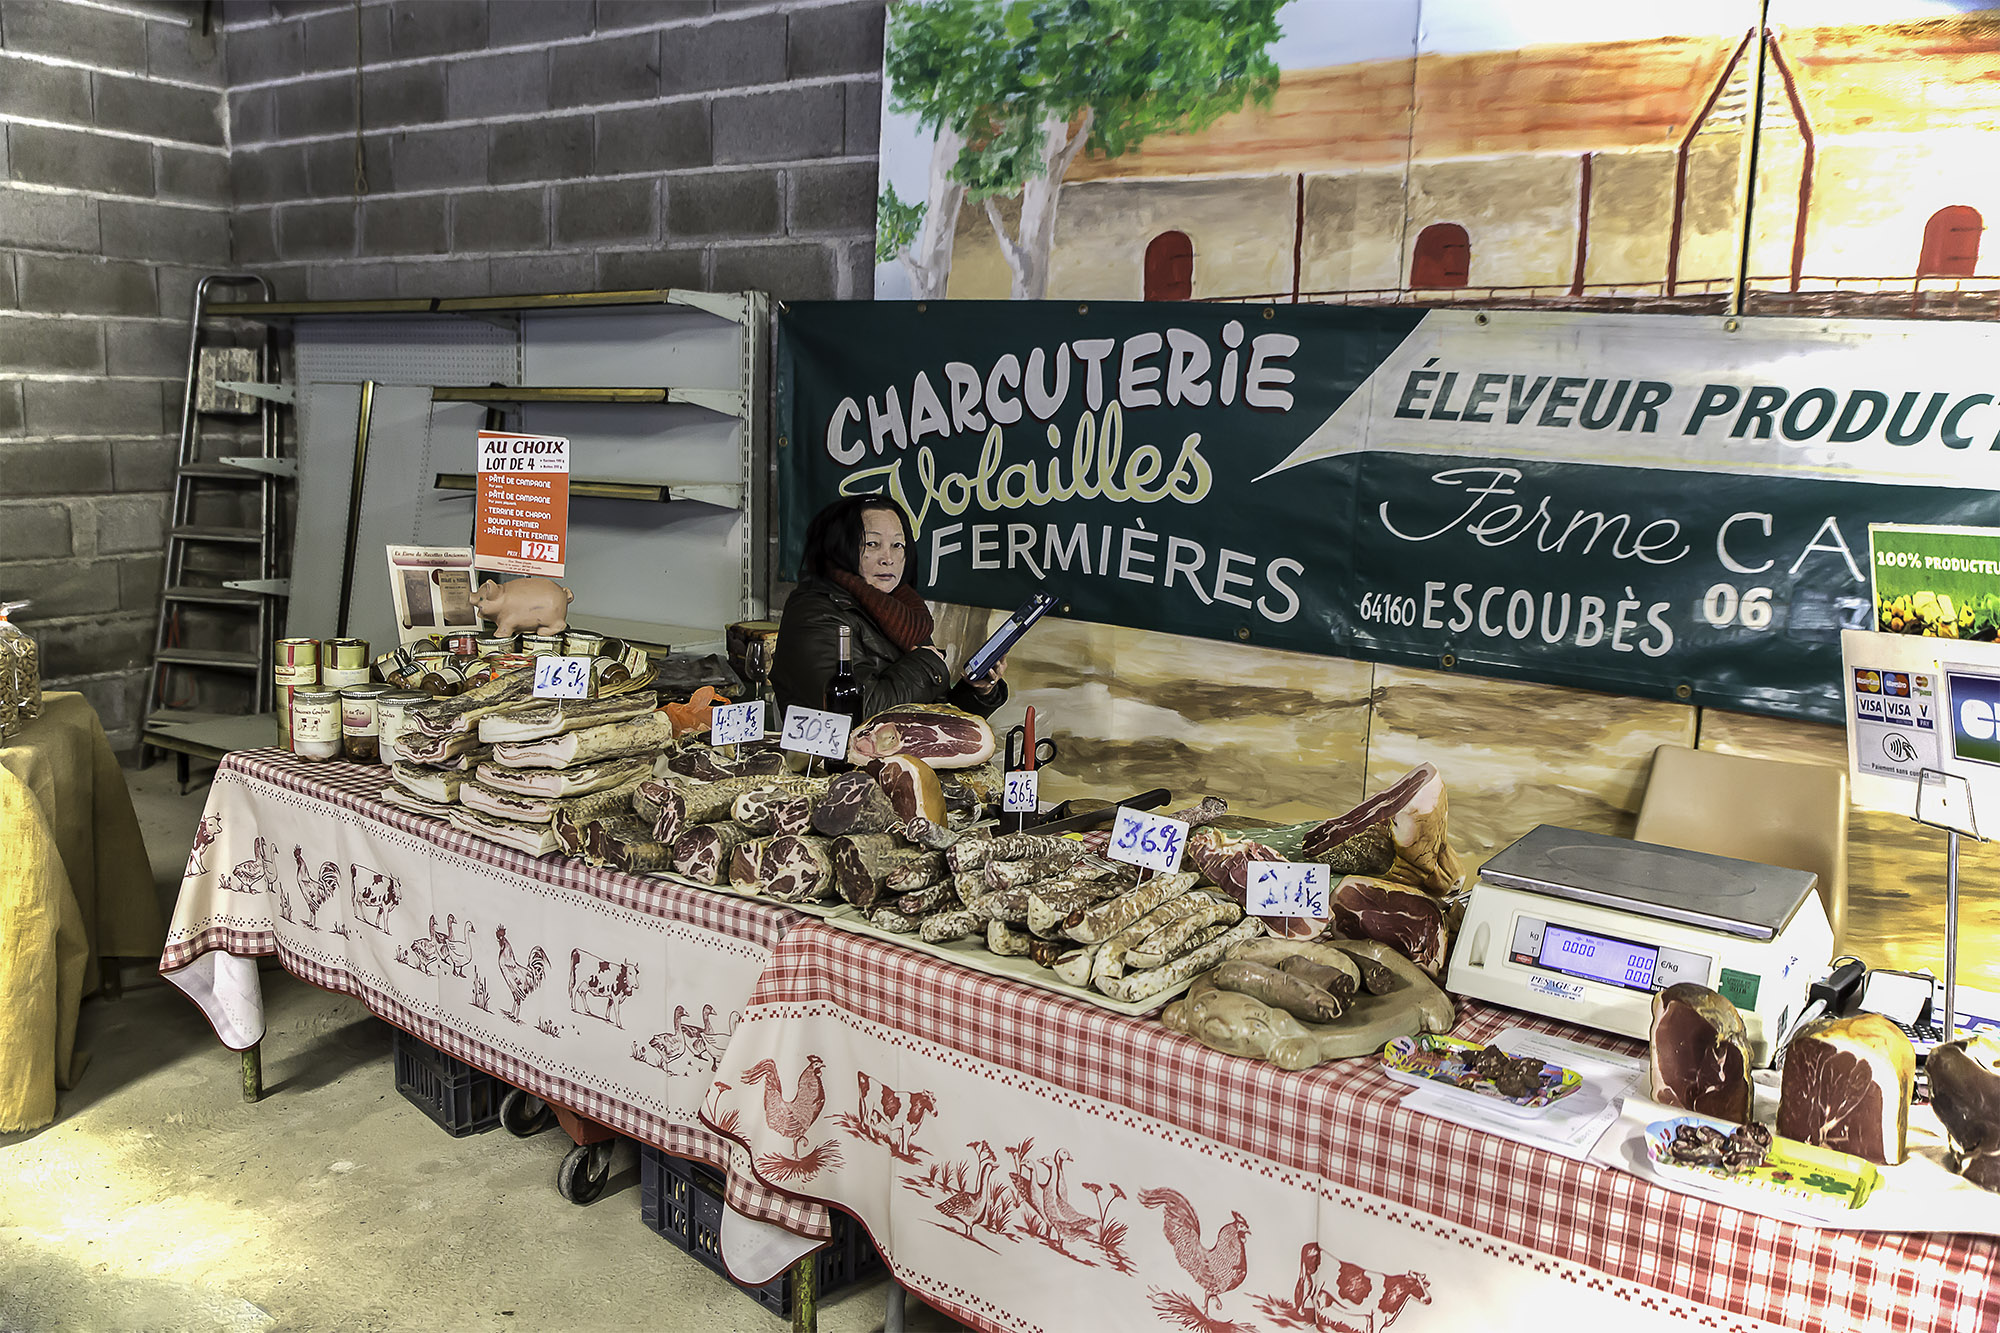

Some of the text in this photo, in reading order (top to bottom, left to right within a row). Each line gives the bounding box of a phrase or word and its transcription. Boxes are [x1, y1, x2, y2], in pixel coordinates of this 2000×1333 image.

[1394, 357, 2000, 451] ÉLEVEUR PRODUC
[484, 441, 564, 454] AU CHOIX
[486, 458, 507, 470] LOT
[510, 458, 524, 470] DE
[527, 458, 535, 470] 4
[839, 400, 1212, 540] Volailles
[488, 474, 551, 488] PÂTÉ DE CAMPAGNE
[488, 489, 551, 504] PÂTÉ DE CAMPAGNE
[488, 507, 551, 520] TERRINE DE CHAPON
[1379, 467, 1690, 564] Ferme
[487, 517, 539, 529] BOUDIN FERMIER
[487, 526, 559, 542] PÂTÉ DE TÊTE FERMIER
[1876, 550, 1922, 569] 100%
[928, 517, 1304, 622] FERMIÈRES
[1360, 592, 1417, 627] 64160
[1422, 582, 1674, 657] ESCOUBÈS
[1703, 583, 1774, 630] 06
[1859, 699, 1928, 717] VISA VISA V
[1871, 763, 1895, 773] Paiement
[1896, 767, 1909, 775] sans
[1530, 931, 1540, 941] kg
[1660, 960, 1679, 972] €/kg
[1530, 975, 1571, 991] PESAGE
[1657, 975, 1664, 983] €
